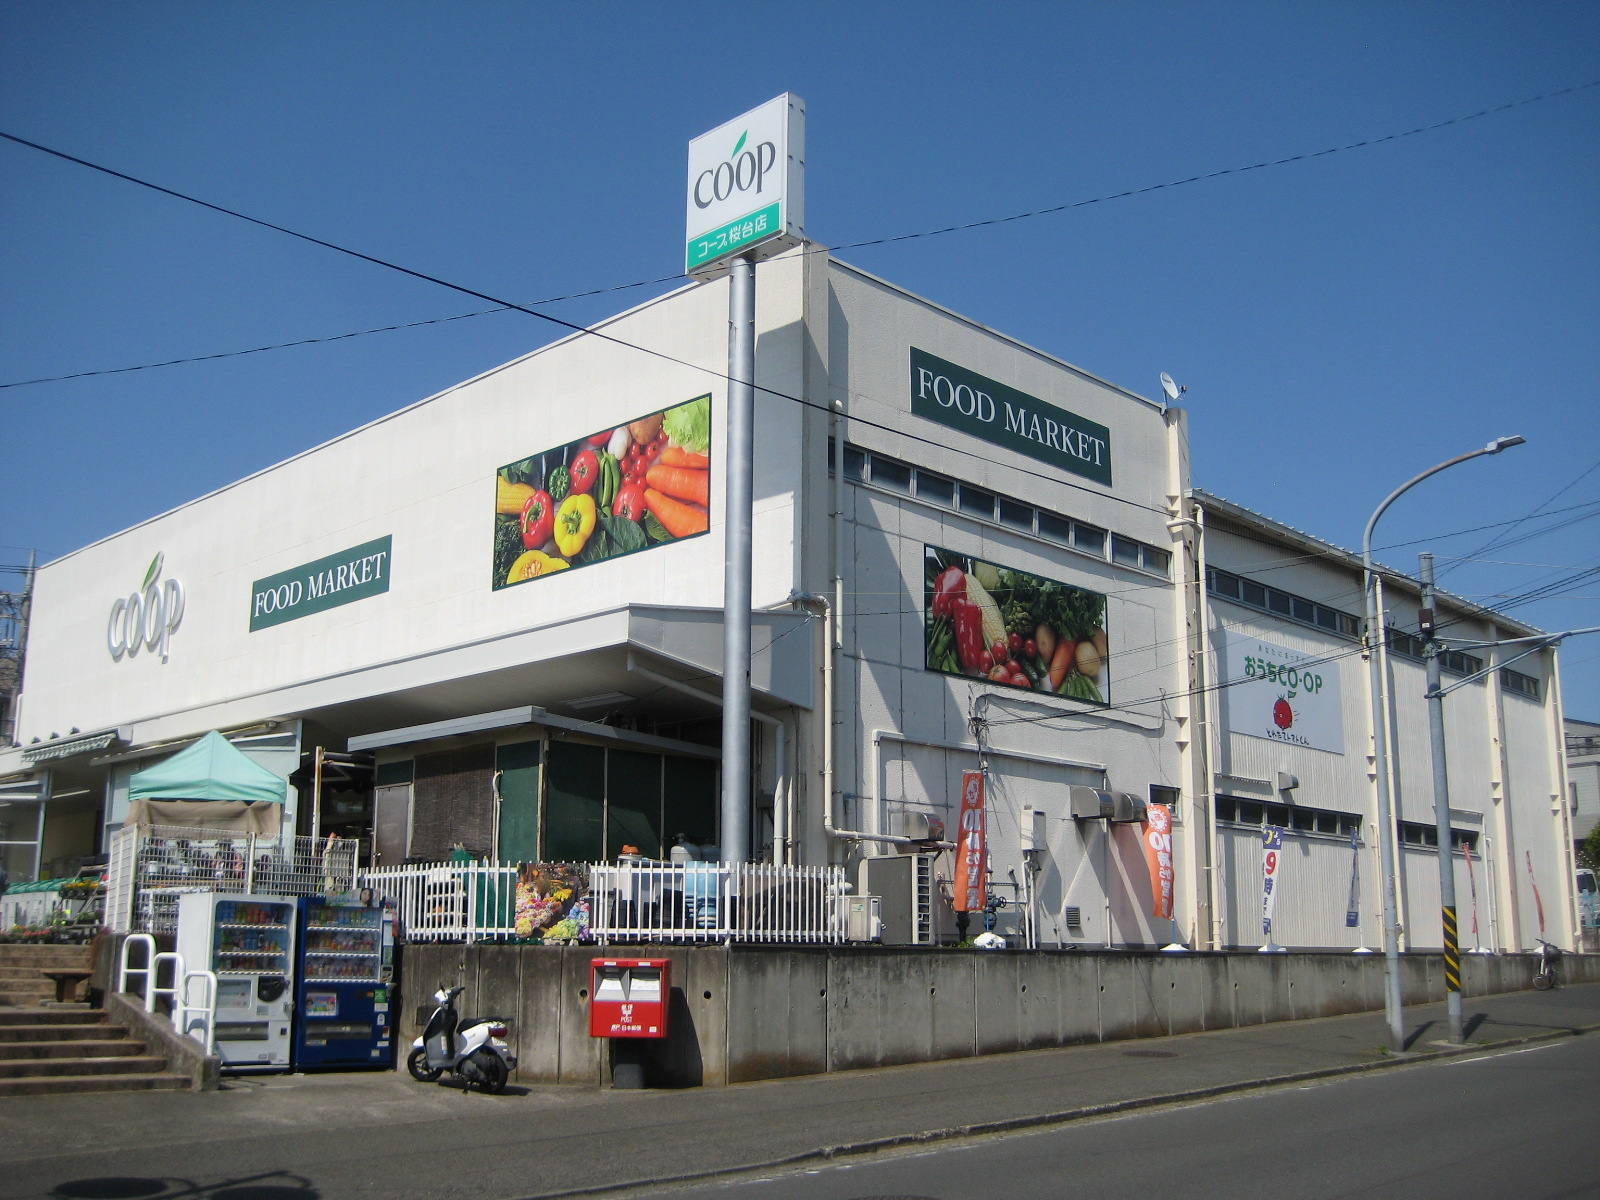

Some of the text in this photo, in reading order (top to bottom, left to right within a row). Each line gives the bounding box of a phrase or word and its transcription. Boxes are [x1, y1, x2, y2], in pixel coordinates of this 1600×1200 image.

[698, 214, 768, 258] コープ桜台店
[917, 366, 1105, 467] FOOD MARKET
[253, 551, 387, 618] FOOD MARKET
